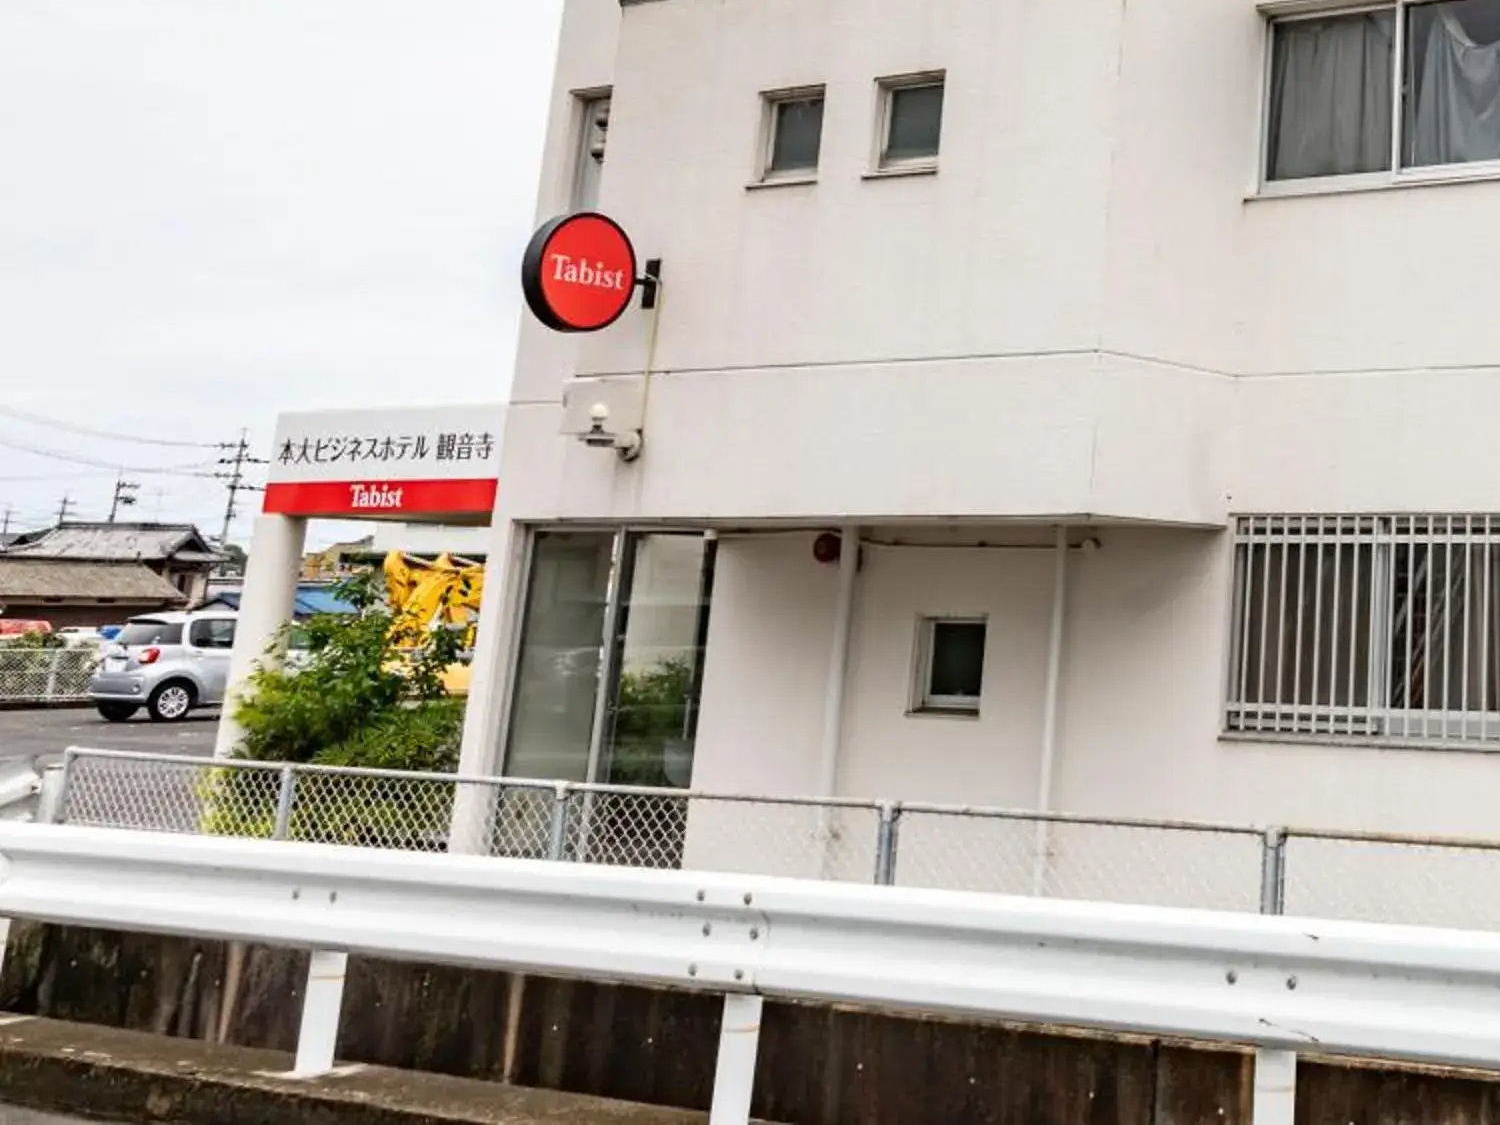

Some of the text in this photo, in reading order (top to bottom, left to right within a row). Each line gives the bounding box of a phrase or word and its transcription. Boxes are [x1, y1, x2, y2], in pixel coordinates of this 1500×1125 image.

[551, 253, 625, 290] Tabist
[278, 431, 495, 465] 本大ビジネスホテル 観音寺
[350, 483, 403, 508] Tabist
